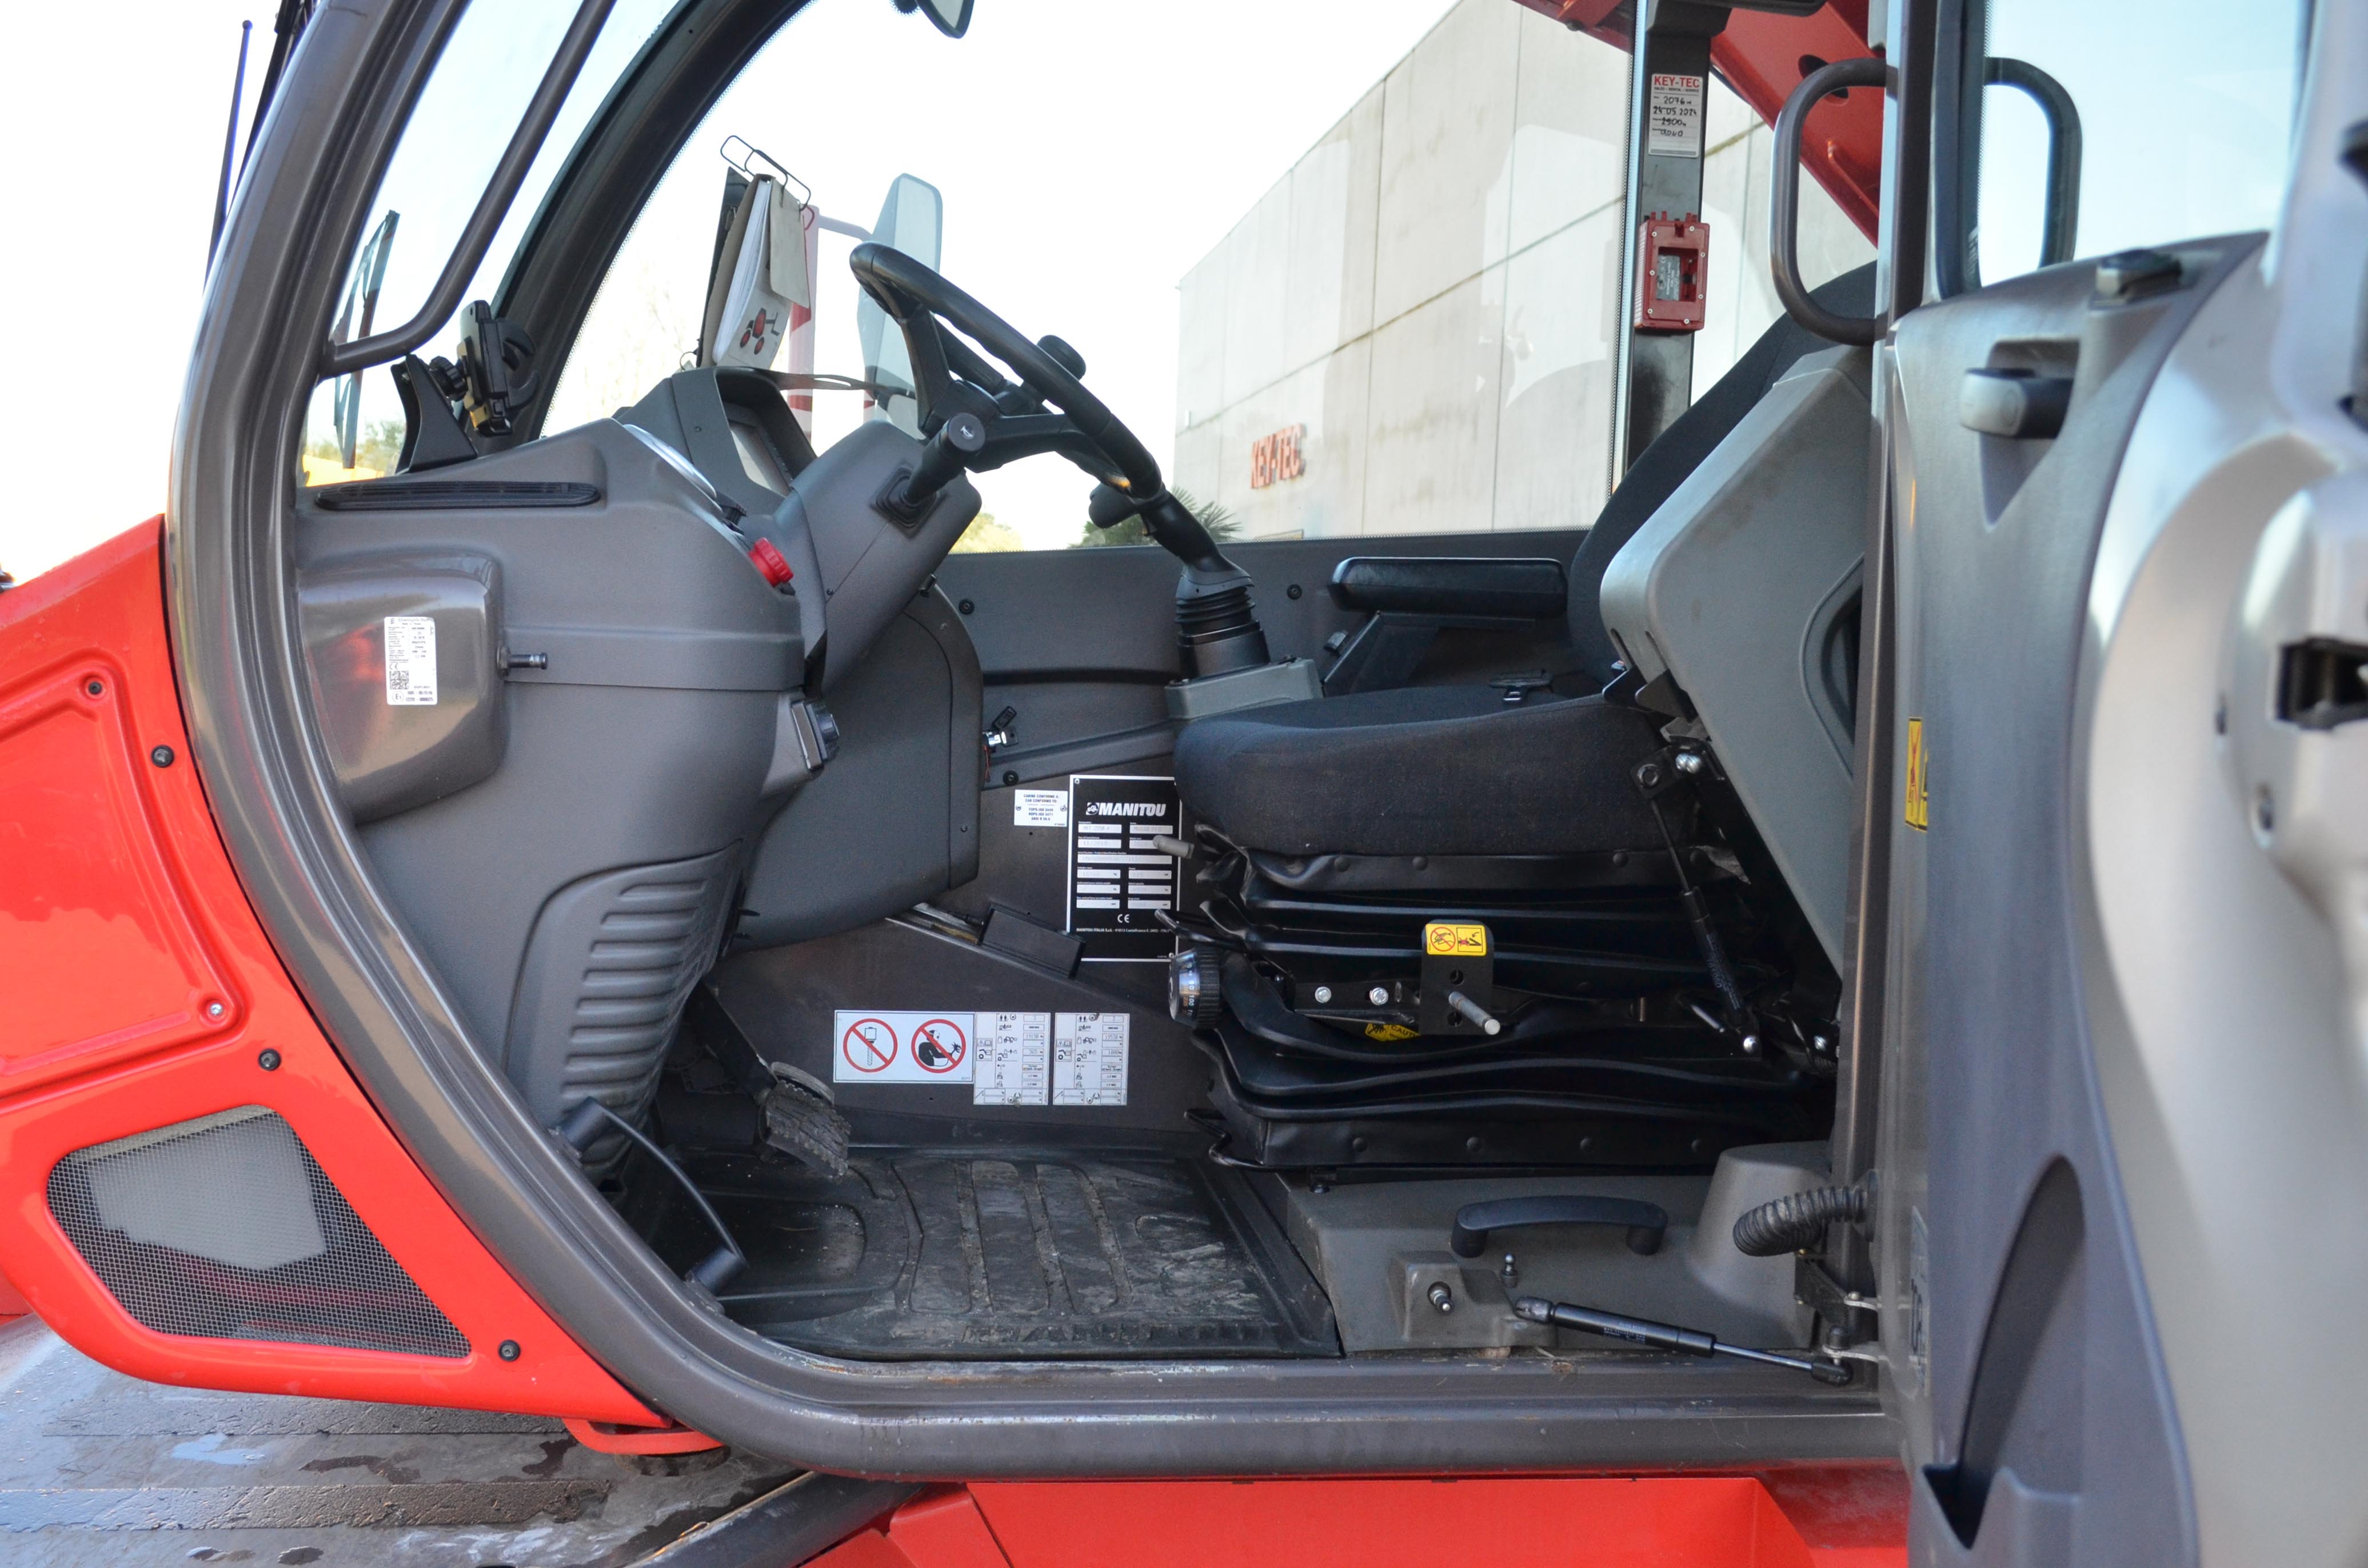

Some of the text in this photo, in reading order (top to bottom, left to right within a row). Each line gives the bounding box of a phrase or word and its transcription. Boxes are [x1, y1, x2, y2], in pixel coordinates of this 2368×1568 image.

[1654, 75, 1700, 88] KEY-TEC
[1099, 803, 1166, 816] MANITOU
[1117, 914, 1129, 923] CE
